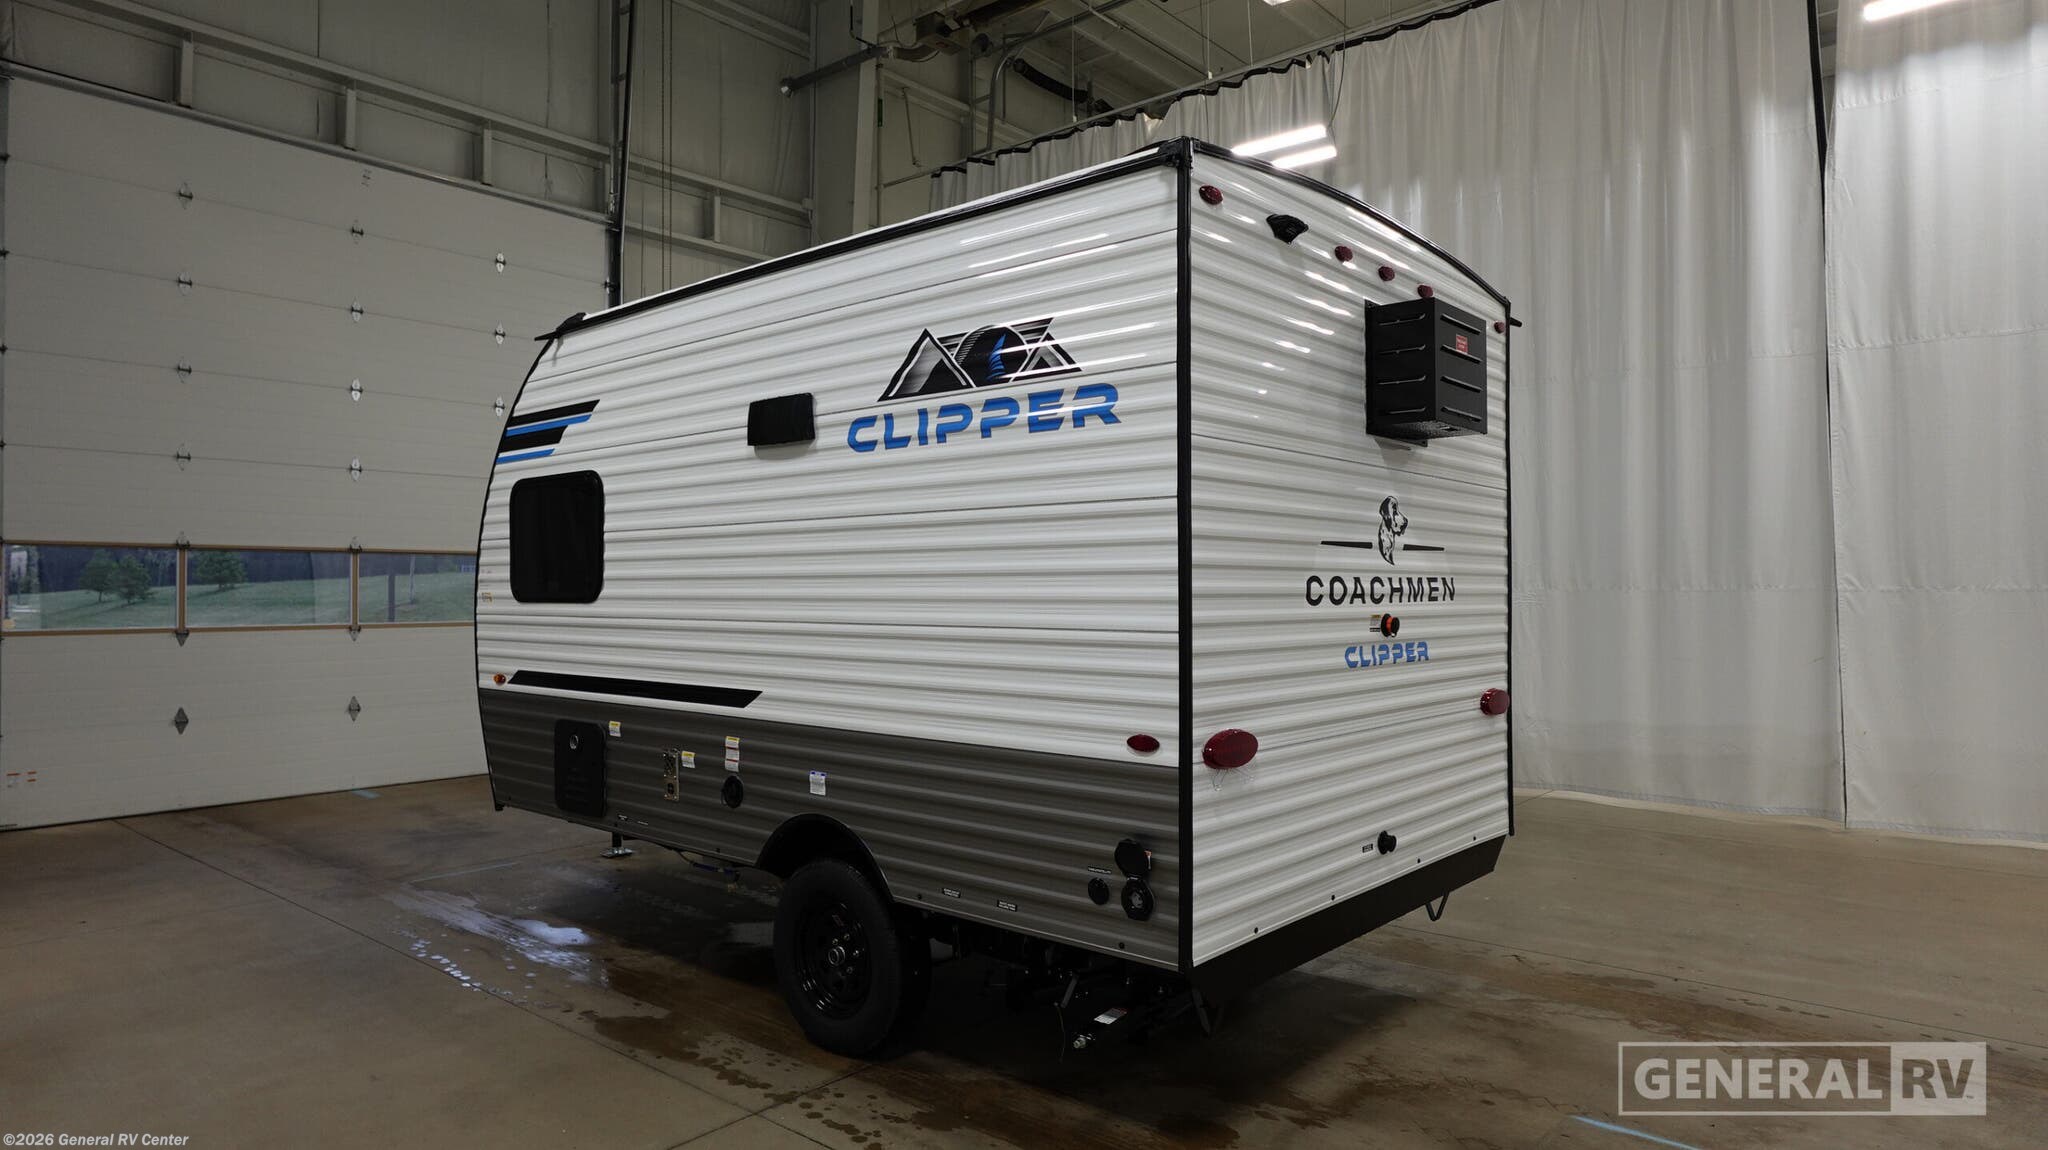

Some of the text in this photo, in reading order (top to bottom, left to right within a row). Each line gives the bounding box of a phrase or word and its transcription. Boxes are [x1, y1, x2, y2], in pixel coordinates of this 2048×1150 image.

[847, 382, 1123, 453] CLIPPER
[1305, 575, 1456, 606] COACHMEN
[1344, 641, 1430, 668] CLIPPER
